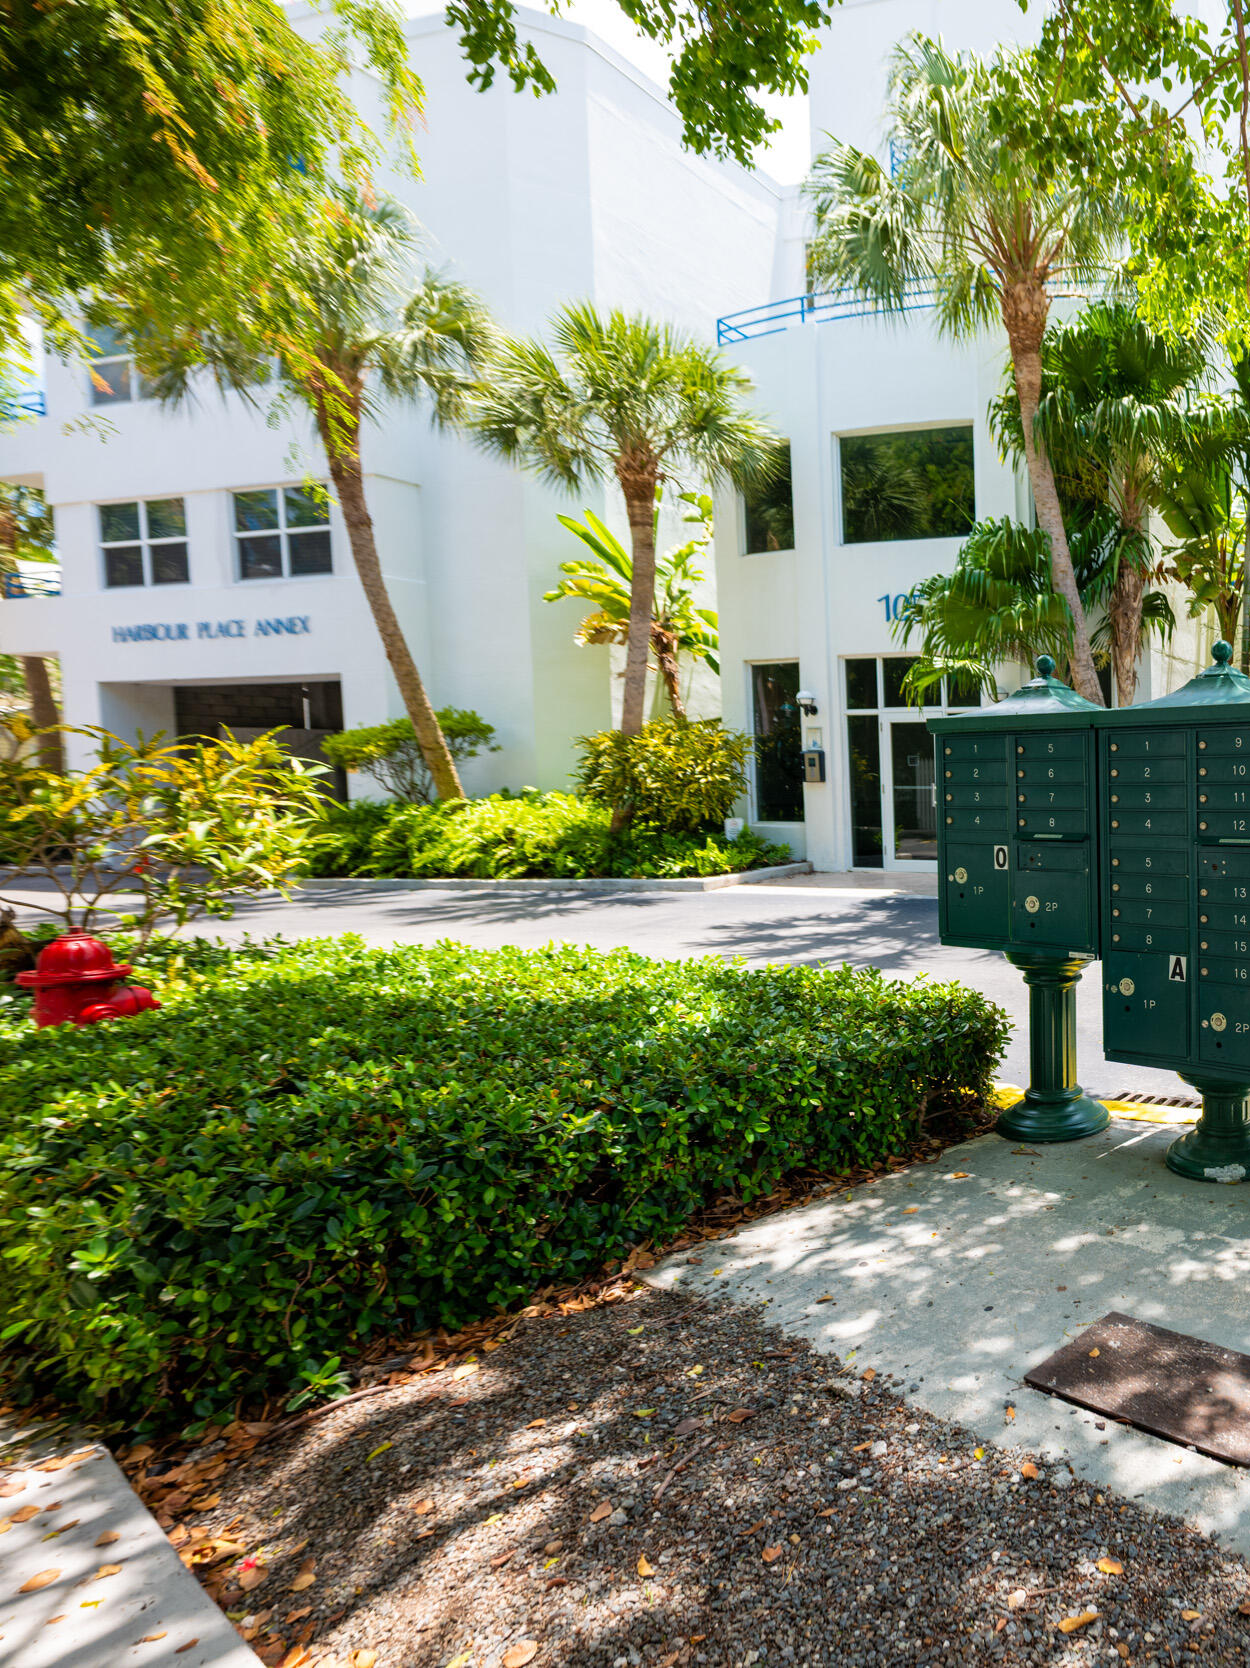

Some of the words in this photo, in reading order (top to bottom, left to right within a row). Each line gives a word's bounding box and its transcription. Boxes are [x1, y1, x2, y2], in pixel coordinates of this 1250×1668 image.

[112, 622, 189, 643] HARBOUR
[196, 618, 247, 640] PLACE
[254, 615, 311, 637] ANNEX
[1047, 743, 1054, 753] 5
[1144, 741, 1149, 751] 1
[1235, 738, 1242, 748] 9
[973, 744, 978, 753] 1
[973, 768, 979, 778] 2
[1048, 768, 1054, 778] 6
[1144, 768, 1151, 778] 2
[1232, 765, 1246, 776] 10
[974, 792, 980, 802] 3
[1048, 793, 1055, 803] 7
[1144, 793, 1151, 803] 3
[1234, 793, 1245, 803] 11
[974, 816, 980, 825] 4
[1049, 818, 1055, 828] 8
[1144, 819, 1151, 829] 4
[1233, 821, 1246, 831] 12
[1145, 858, 1152, 868] 5
[972, 885, 984, 895] 1P
[1145, 884, 1152, 894] 6
[1234, 888, 1247, 898] 13
[1045, 901, 1057, 911] 2P
[1146, 909, 1153, 919] 7
[1234, 915, 1247, 925] 14
[1145, 935, 1153, 945] 8
[1234, 942, 1247, 952] 15
[1170, 957, 1185, 981] A
[1234, 969, 1248, 980] 16
[1143, 999, 1156, 1009] 1P
[1235, 1023, 1250, 1033] 2P
